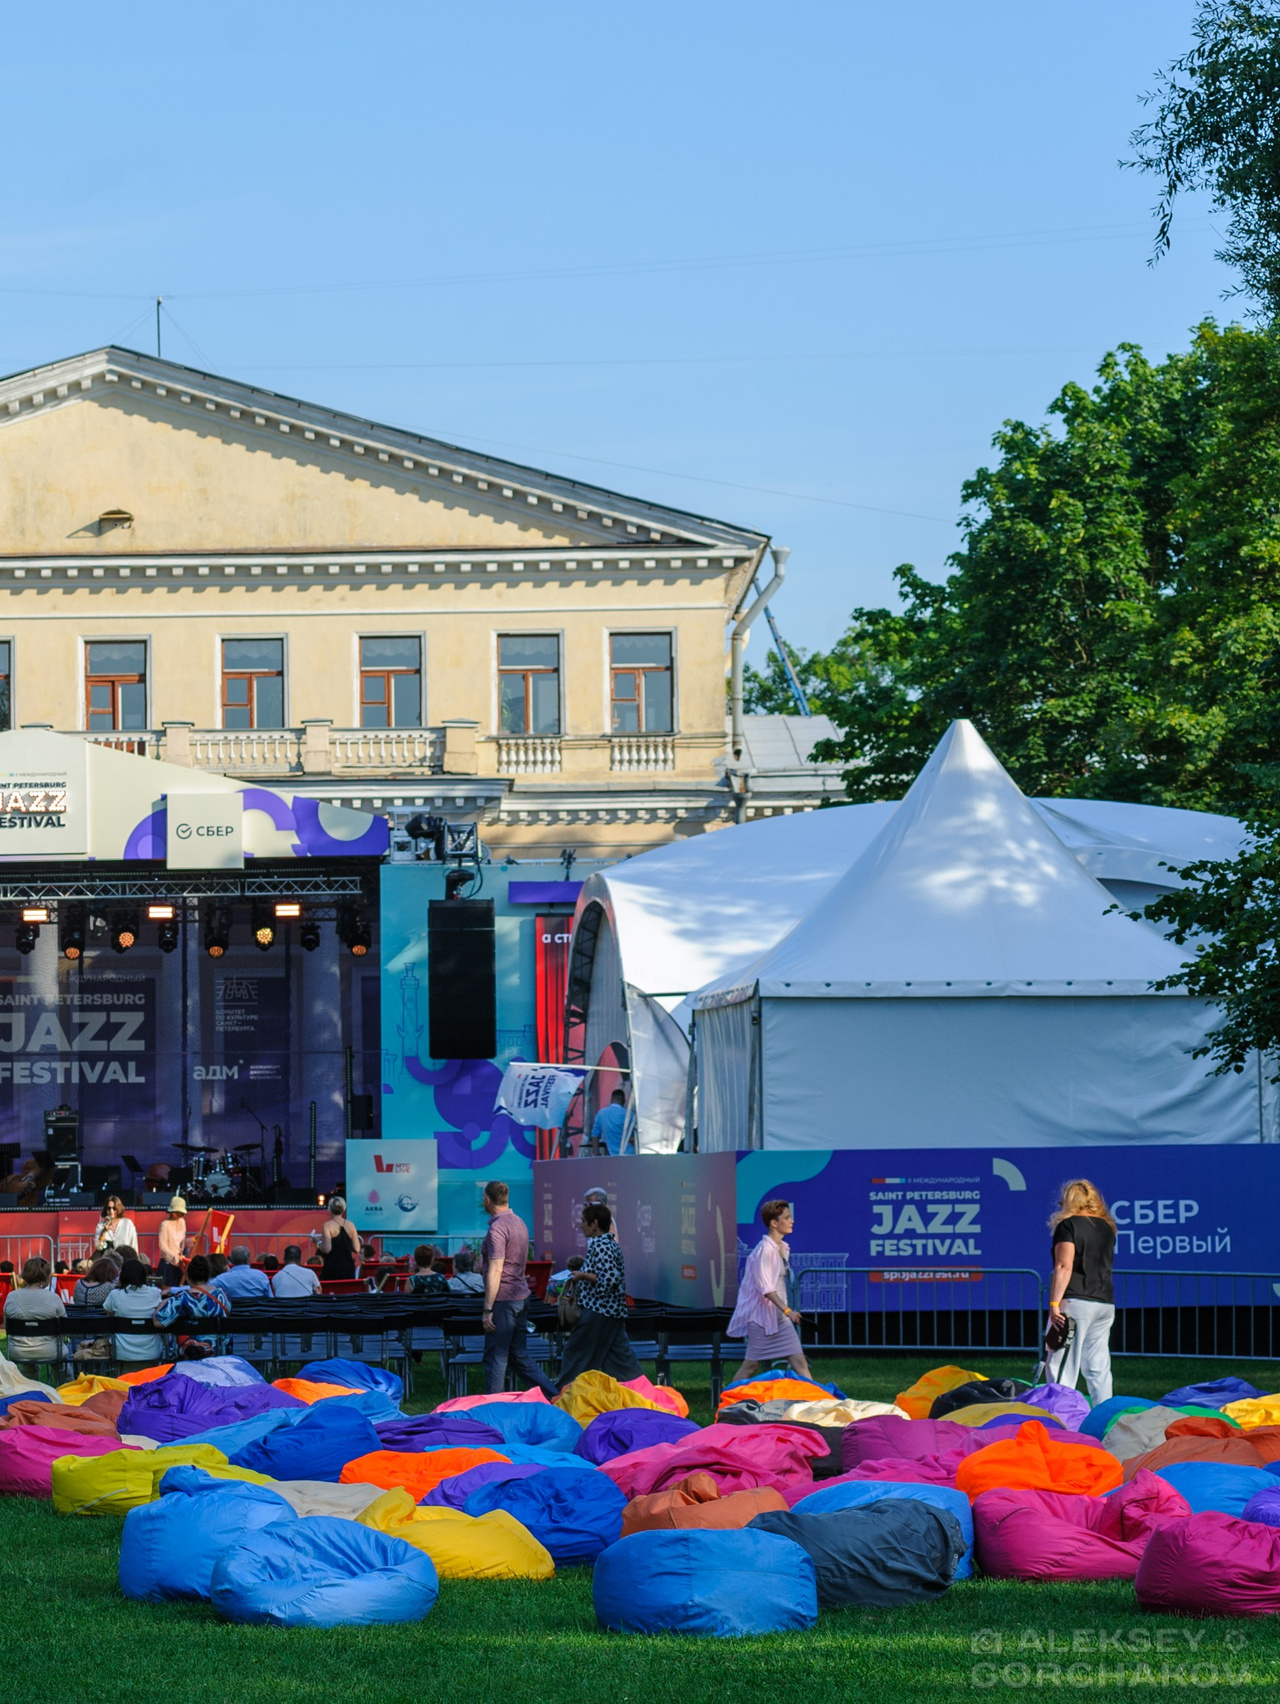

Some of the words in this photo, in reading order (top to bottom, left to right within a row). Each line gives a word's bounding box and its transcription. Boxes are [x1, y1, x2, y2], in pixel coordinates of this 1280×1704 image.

[12, 781, 67, 789] PETERSBURG
[196, 826, 234, 837] СБЕР
[913, 1176, 980, 1184] МЕЖДУНАРОДНЫЙ
[869, 1191, 903, 1200] SAINT
[906, 1190, 980, 1200] PETERSBURG
[870, 1203, 981, 1235] JAZZ
[1110, 1199, 1200, 1225] СБЕР
[870, 1238, 982, 1256] FESTIVAL
[1114, 1227, 1231, 1259] Первый
